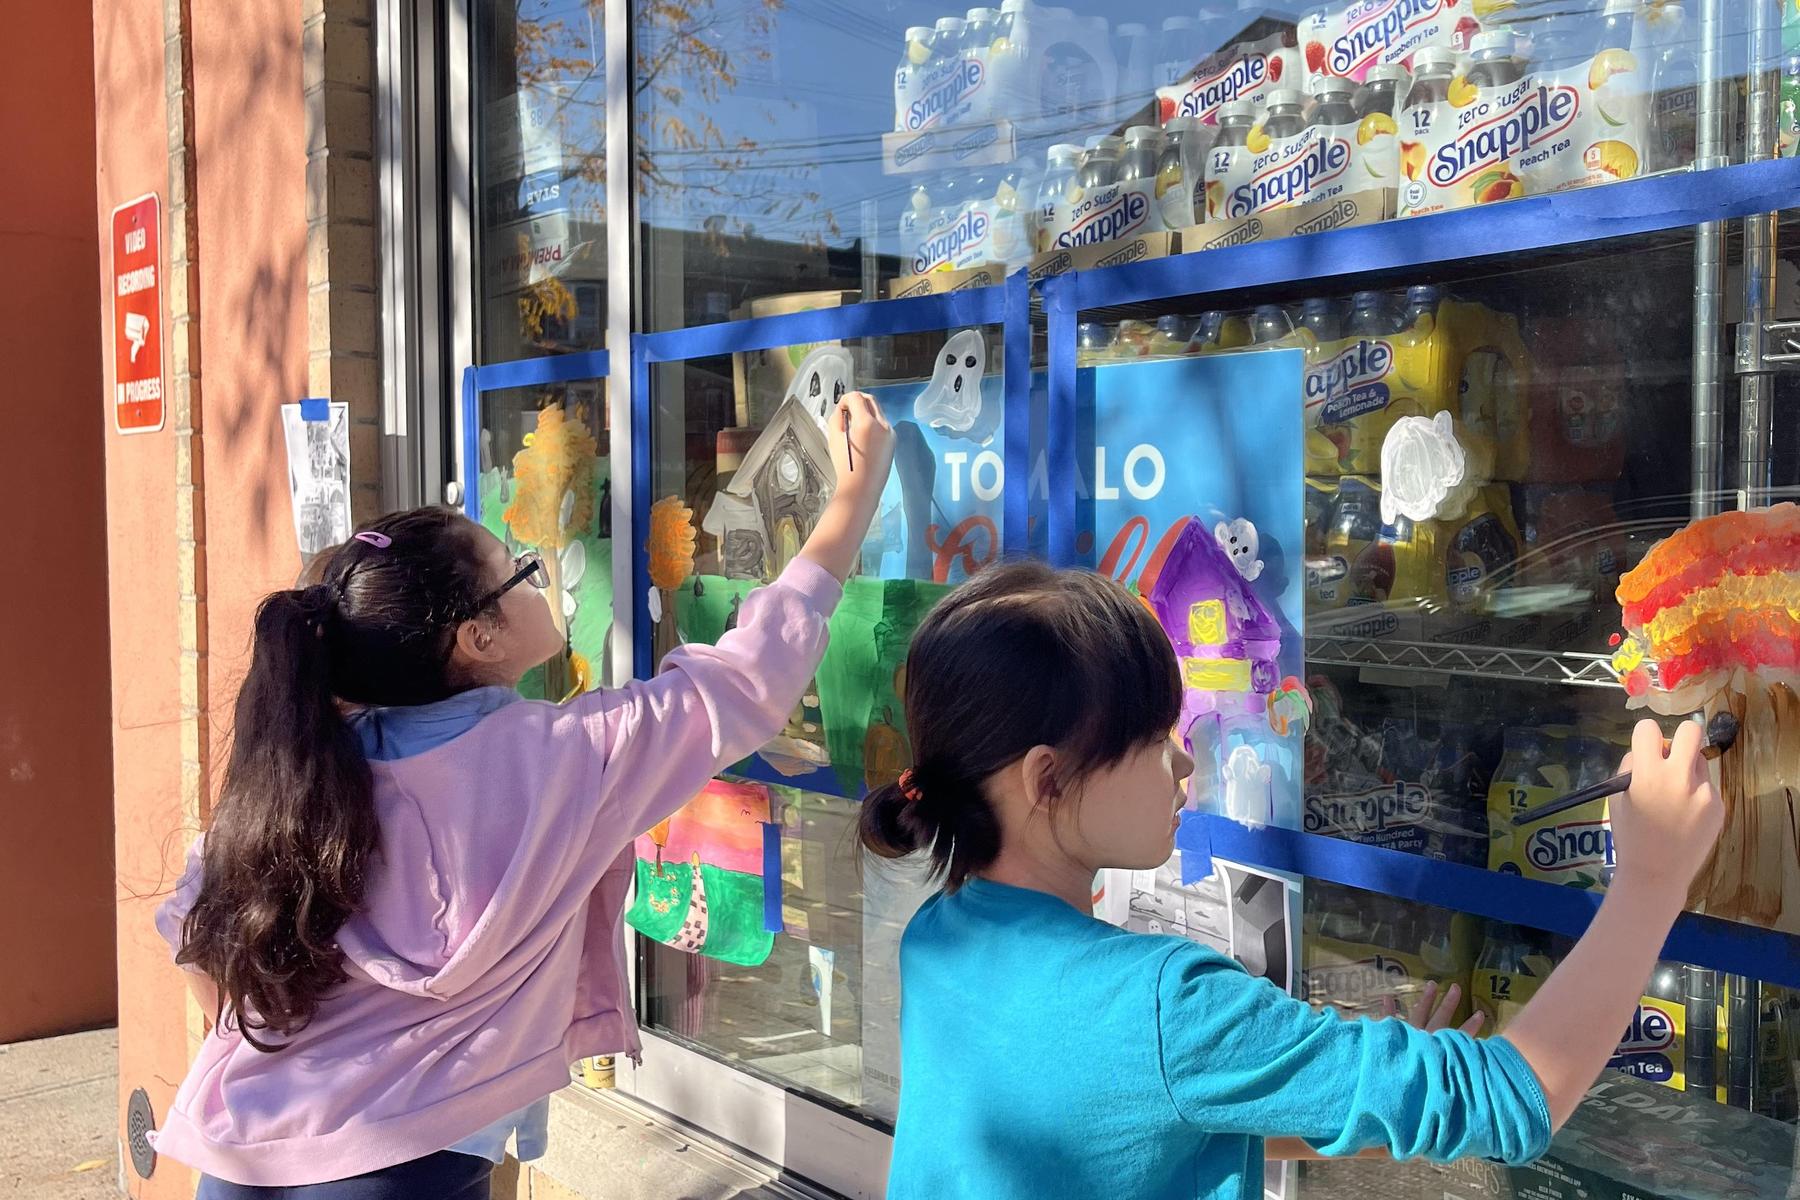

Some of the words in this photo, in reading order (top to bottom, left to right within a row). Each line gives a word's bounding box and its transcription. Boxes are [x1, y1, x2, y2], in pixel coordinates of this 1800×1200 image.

[1347, 2, 1374, 24] zero
[1385, 34, 1422, 63] Raspberry
[1424, 25, 1439, 38] Tea
[910, 60, 981, 130] Snapple
[1182, 53, 1265, 117] Snapple
[1251, 93, 1265, 103] Tea
[1412, 110, 1431, 128] 12
[1458, 104, 1489, 130] zero
[1434, 85, 1573, 182] Snapple
[1214, 152, 1231, 168] 12
[1252, 153, 1280, 173] zero
[1519, 151, 1550, 168] Peach
[1551, 139, 1571, 154] Tea
[1231, 137, 1346, 218] Snapple
[1327, 184, 1343, 197] Tea
[1072, 201, 1091, 222] zero
[1094, 186, 1119, 208] Sugar
[125, 228, 146, 255] VIDEO
[916, 211, 985, 273] Snapple
[118, 265, 155, 296] RECORDING
[118, 383, 125, 404] IN
[126, 376, 161, 403] PROGRESS
[1340, 396, 1385, 417] Lemonade
[1508, 788, 1528, 808] 12
[1376, 828, 1415, 842] Hundred
[1490, 976, 1511, 993] 12
[1638, 1062, 1664, 1074] Tea
[1611, 1091, 1720, 1124] DAY
